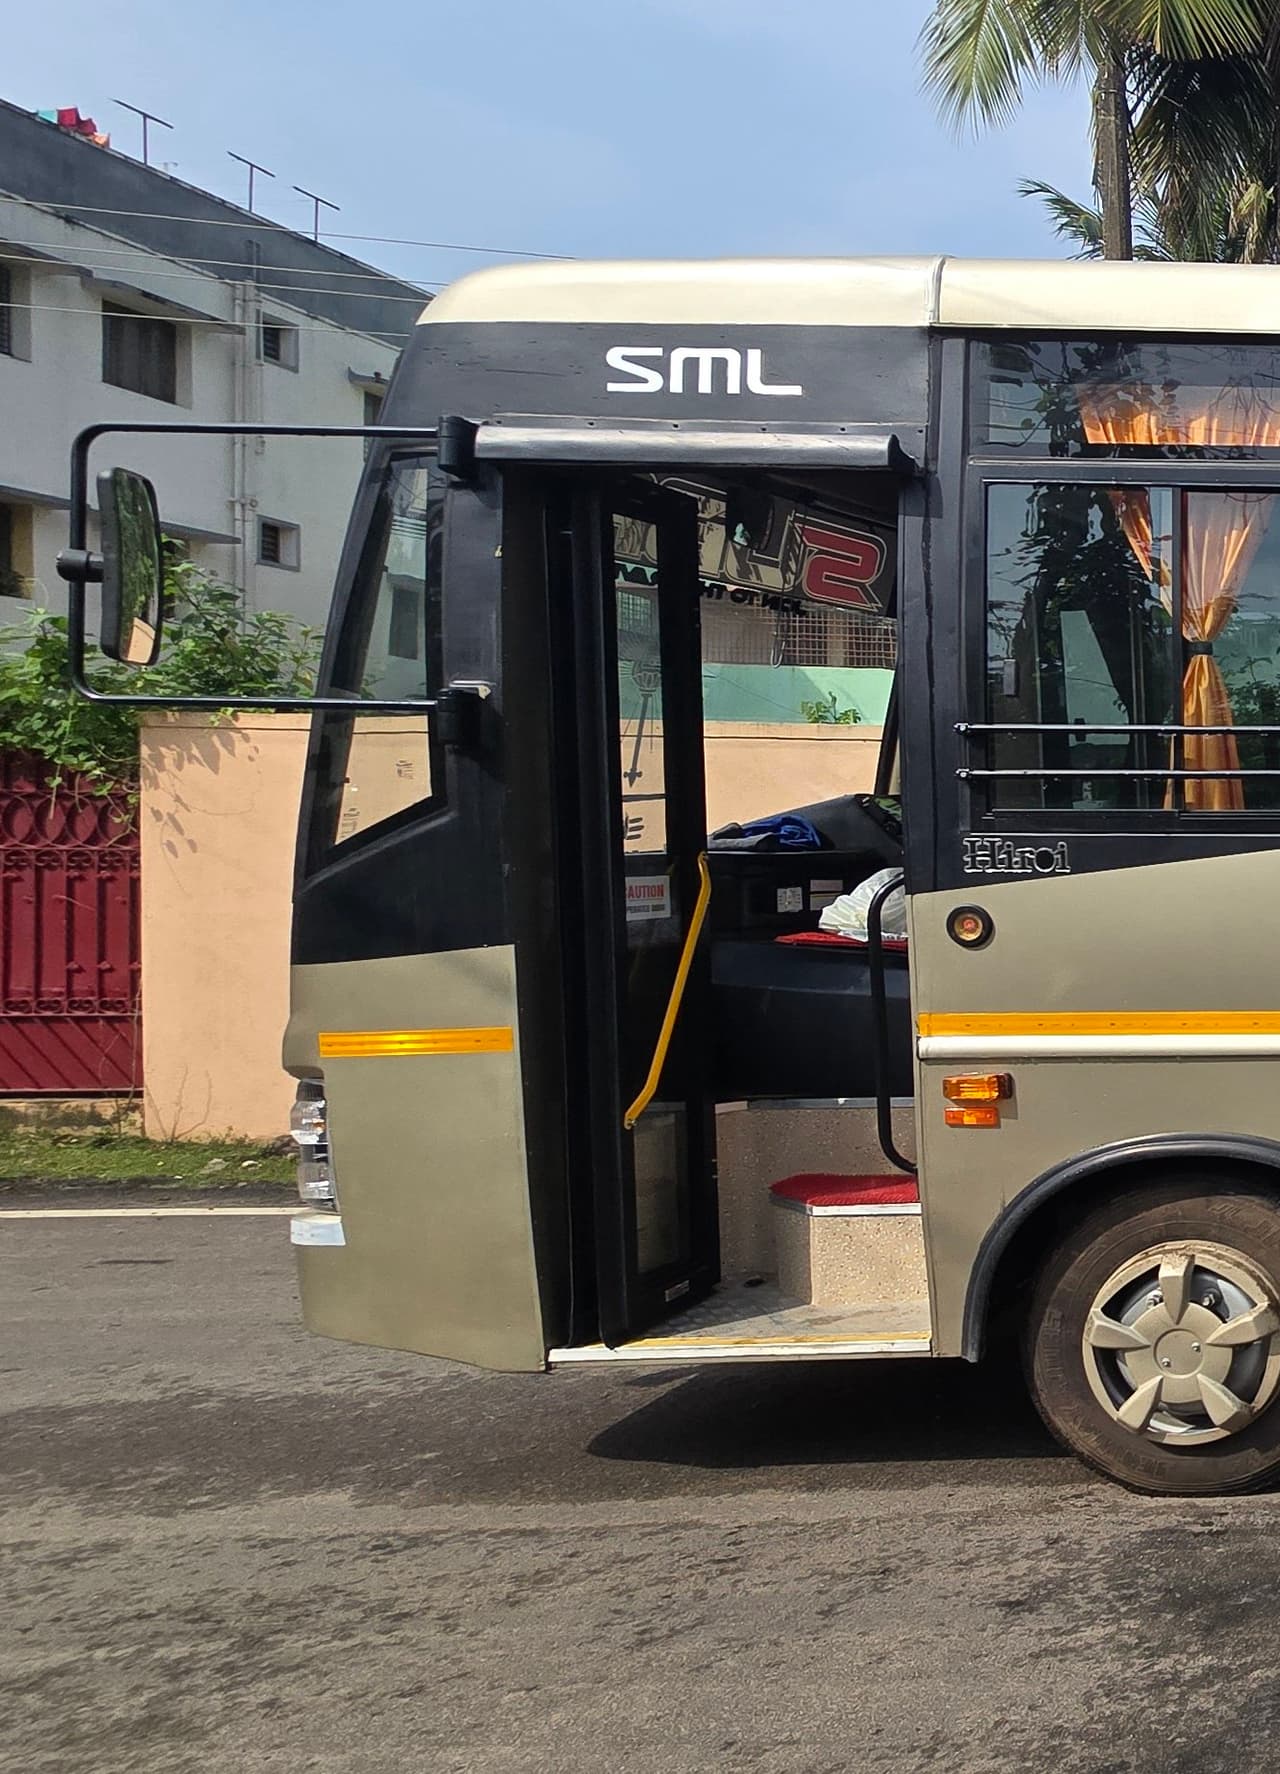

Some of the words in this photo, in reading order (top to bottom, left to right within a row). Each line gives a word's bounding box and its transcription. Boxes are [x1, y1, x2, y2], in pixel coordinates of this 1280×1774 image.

[606, 346, 803, 396] SML
[963, 837, 1071, 873] Hiroi
[628, 884, 665, 899] AUTION
